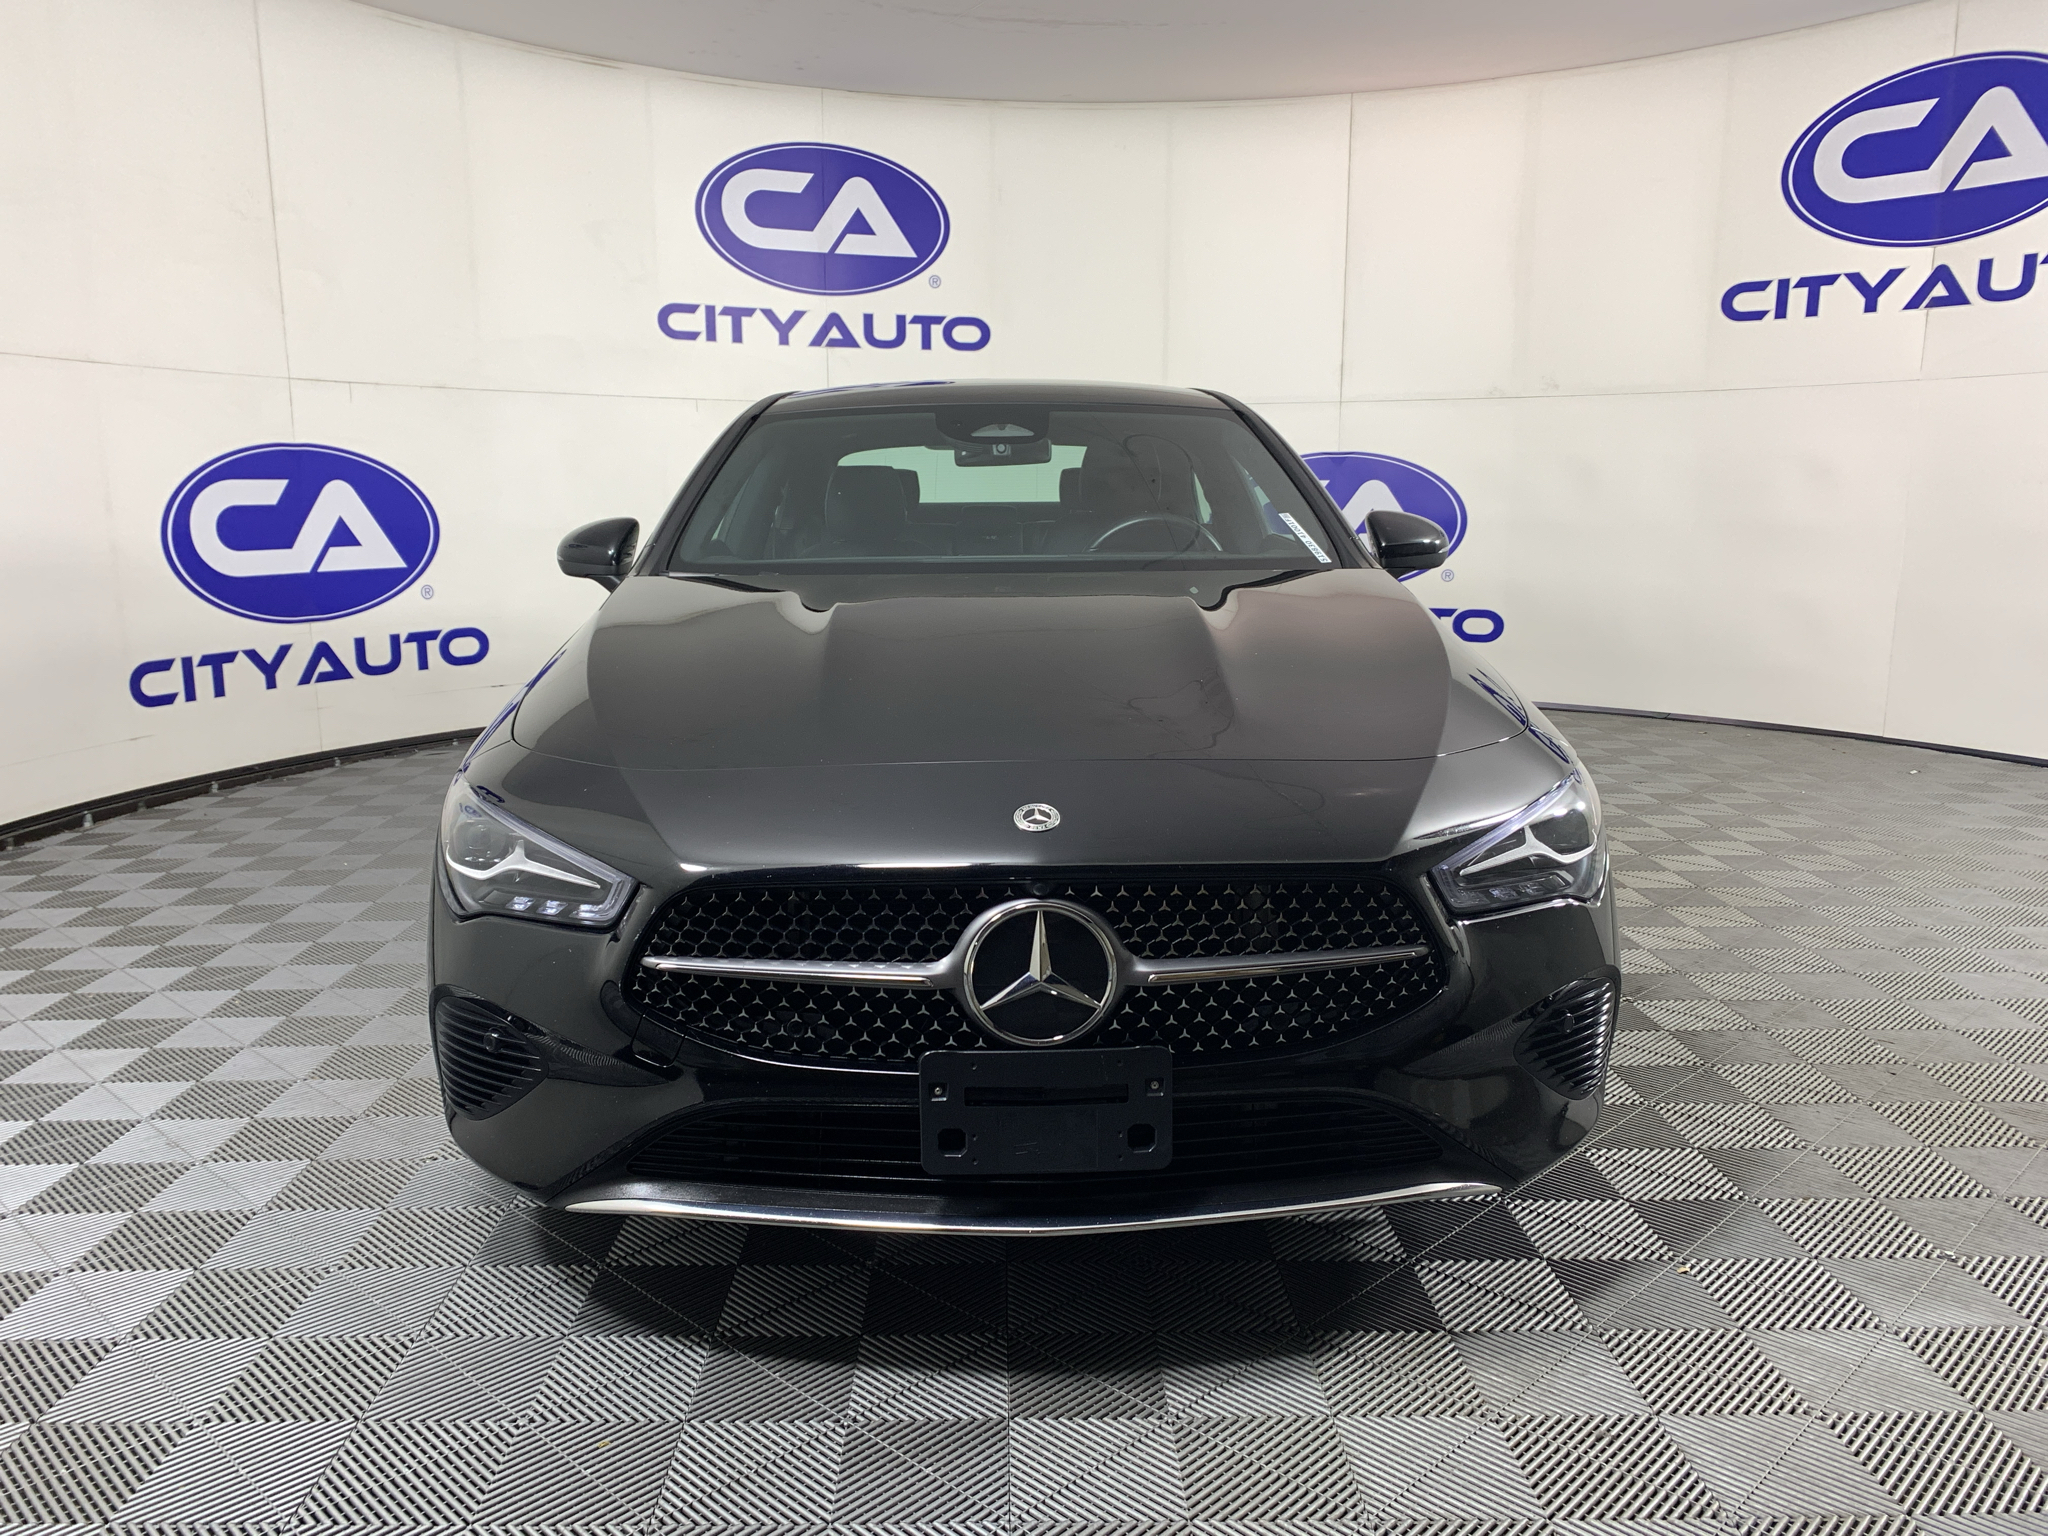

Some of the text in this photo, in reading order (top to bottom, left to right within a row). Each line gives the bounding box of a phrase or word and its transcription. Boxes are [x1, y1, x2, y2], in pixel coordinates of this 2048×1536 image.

[1813, 85, 2048, 204] CA
[720, 168, 918, 258] CA
[189, 478, 408, 578] CA
